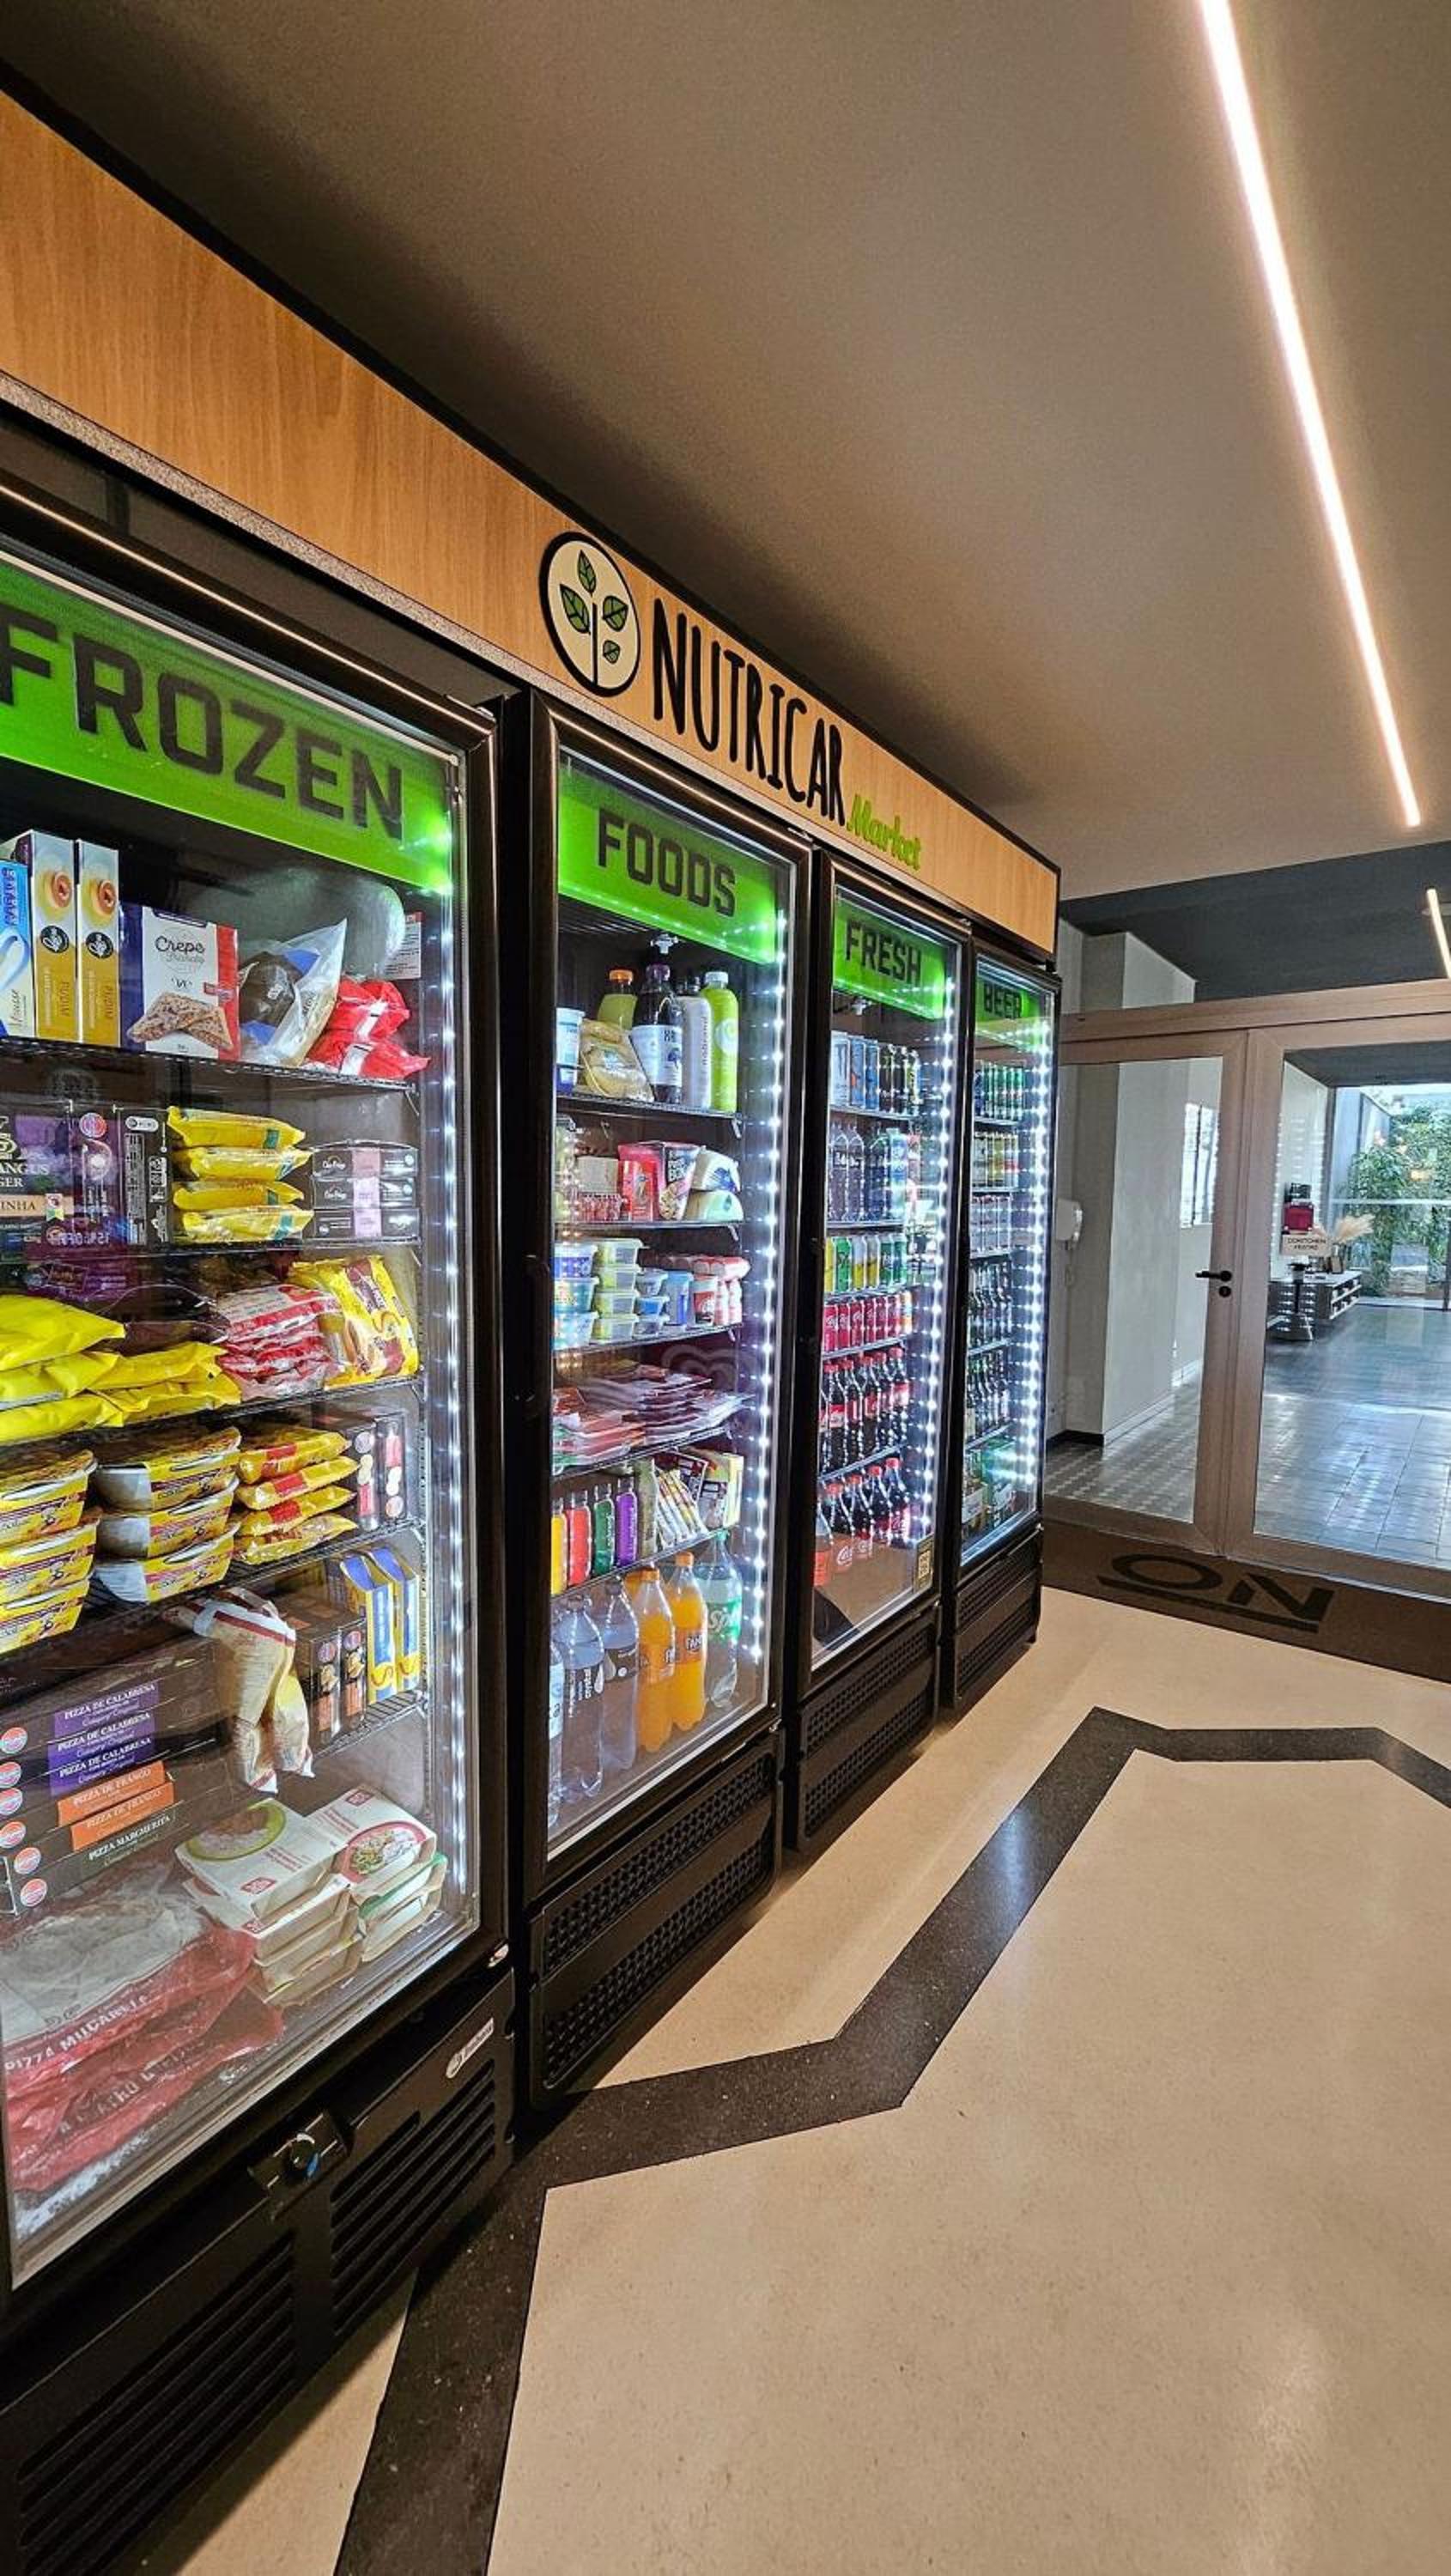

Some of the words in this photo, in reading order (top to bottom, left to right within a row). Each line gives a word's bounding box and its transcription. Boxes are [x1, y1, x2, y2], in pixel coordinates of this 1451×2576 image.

[0, 610, 403, 840] FROZEN
[653, 597, 846, 826] NUTRICAR
[597, 807, 736, 918] FOODS
[847, 793, 921, 872] Market
[155, 936, 205, 954] Crepe
[846, 920, 921, 987] FRESH
[983, 981, 1021, 1019] BEER
[1111, 1552, 1336, 1621] ON
